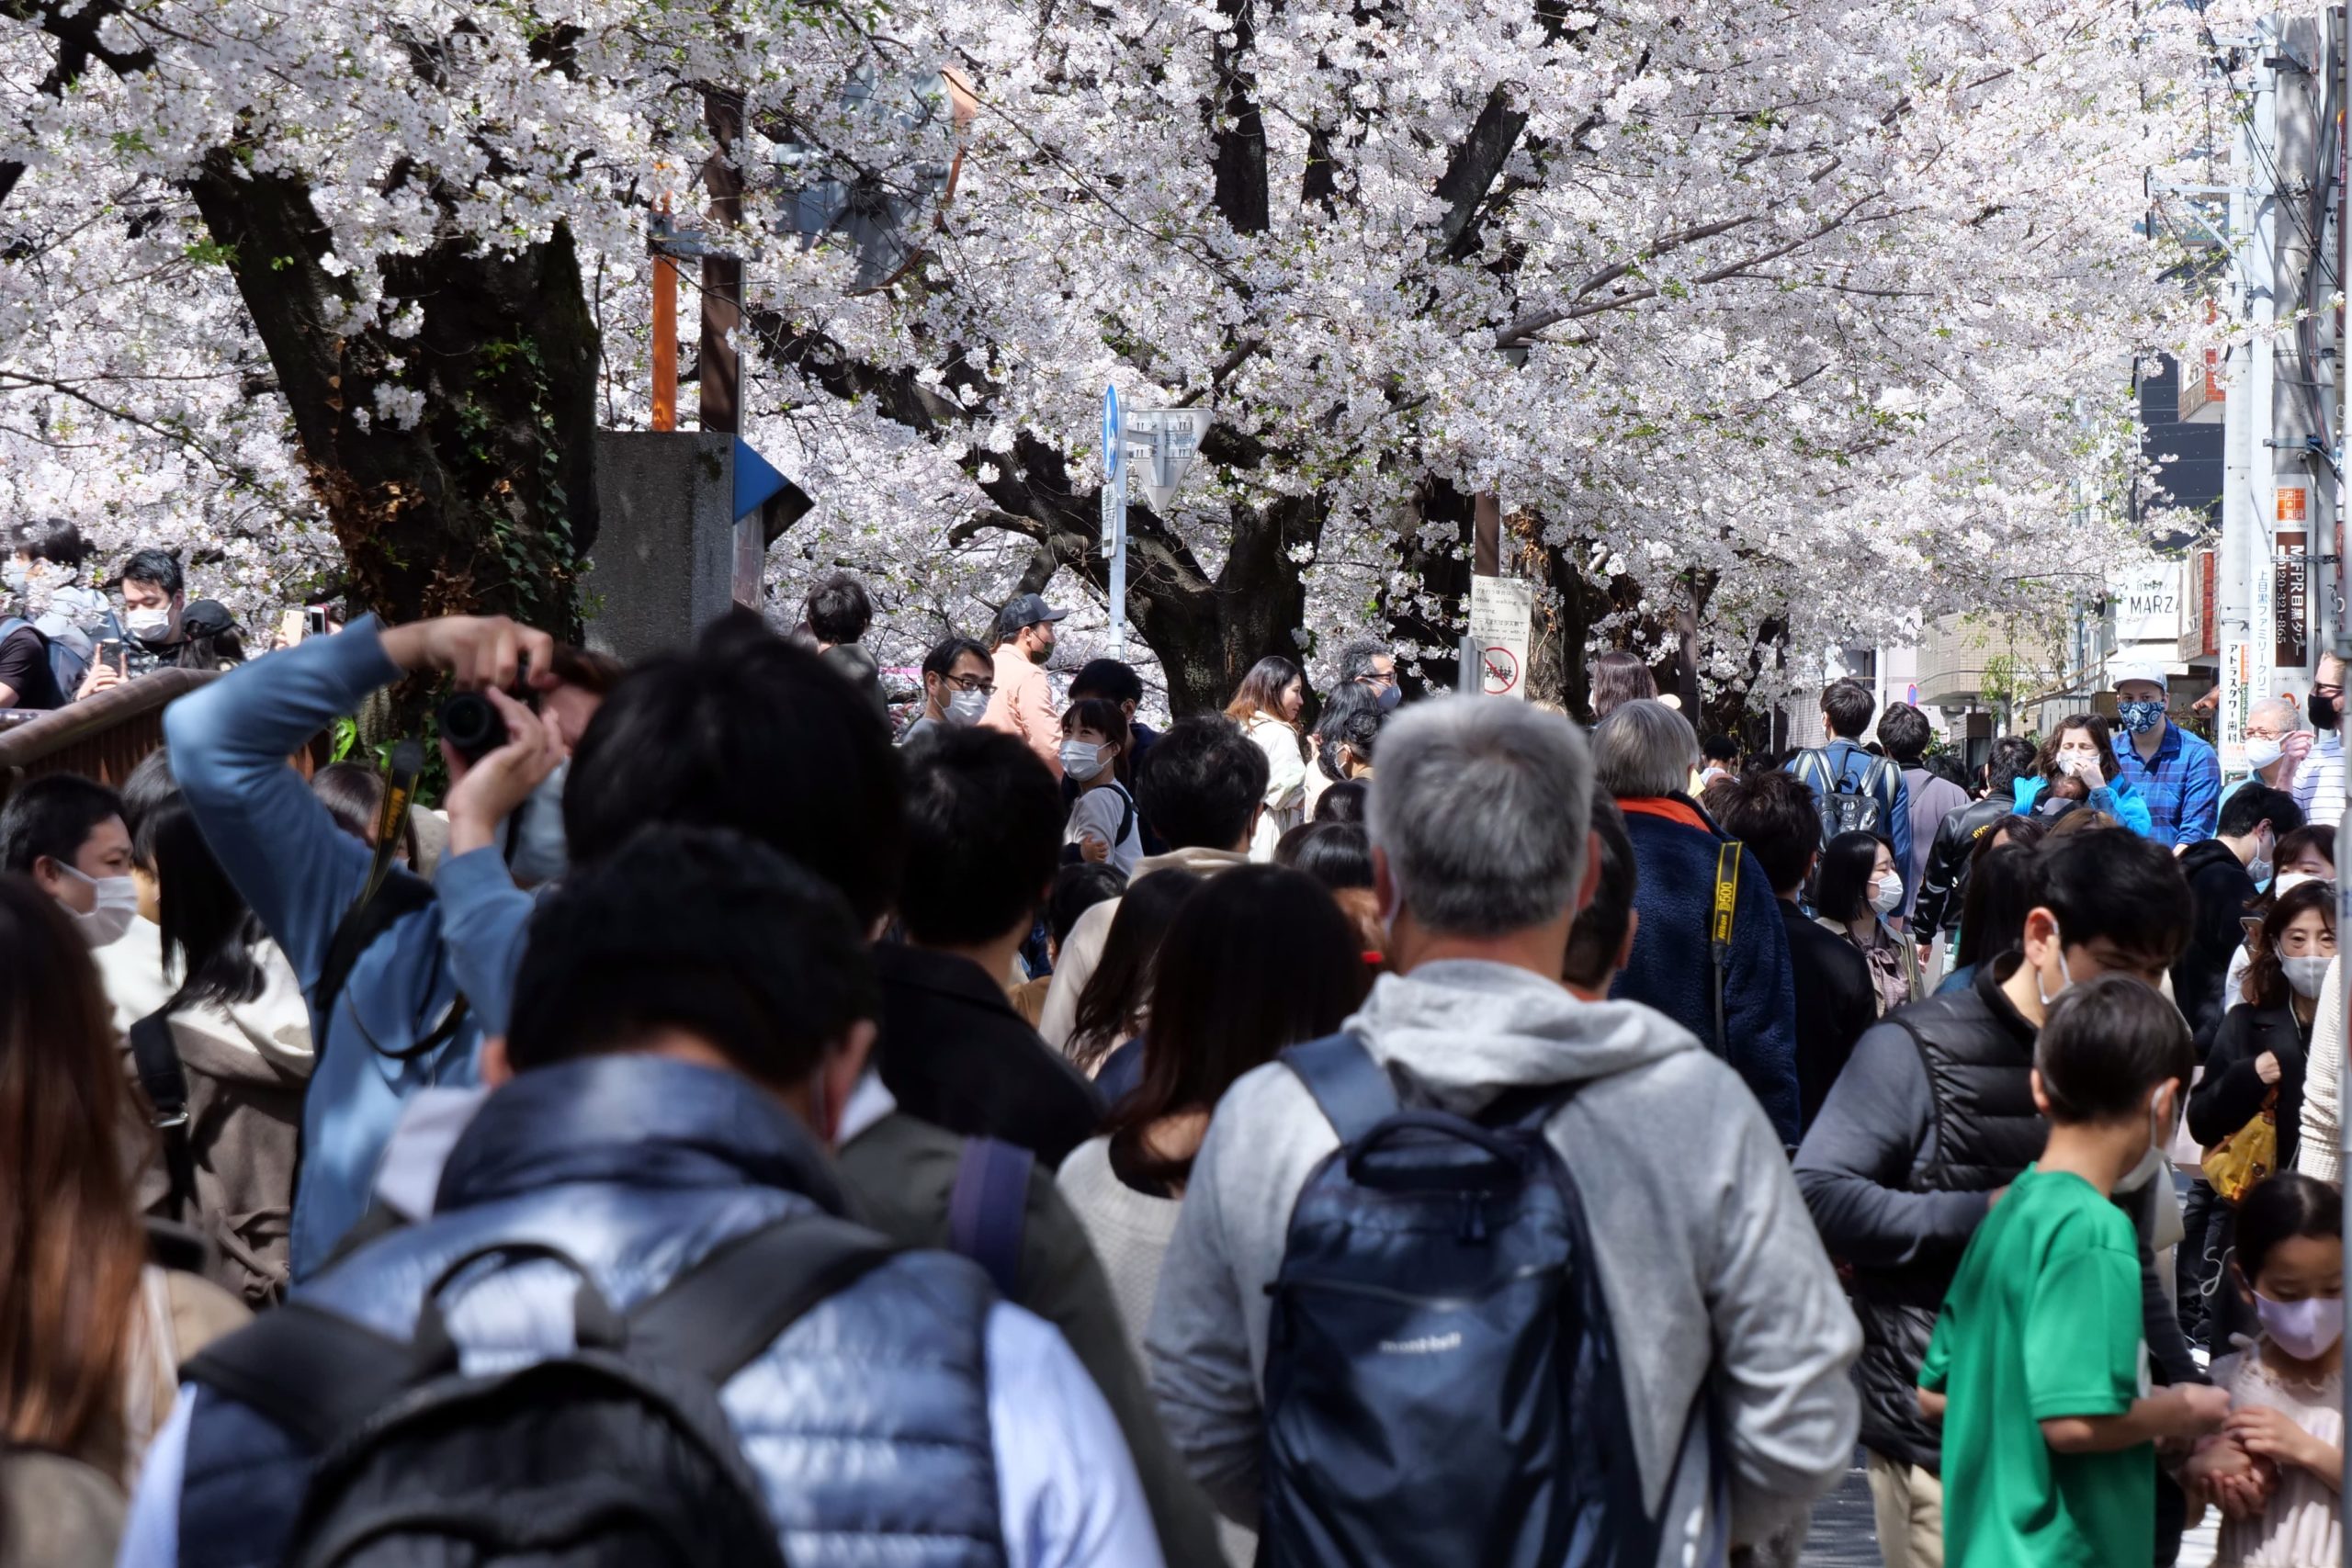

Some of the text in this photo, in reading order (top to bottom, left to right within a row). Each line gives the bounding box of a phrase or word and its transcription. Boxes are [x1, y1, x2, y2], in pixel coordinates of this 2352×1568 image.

[2227, 644, 2238, 744] アトラスタワー歯科
[1717, 882, 1733, 940] Nikon D500
